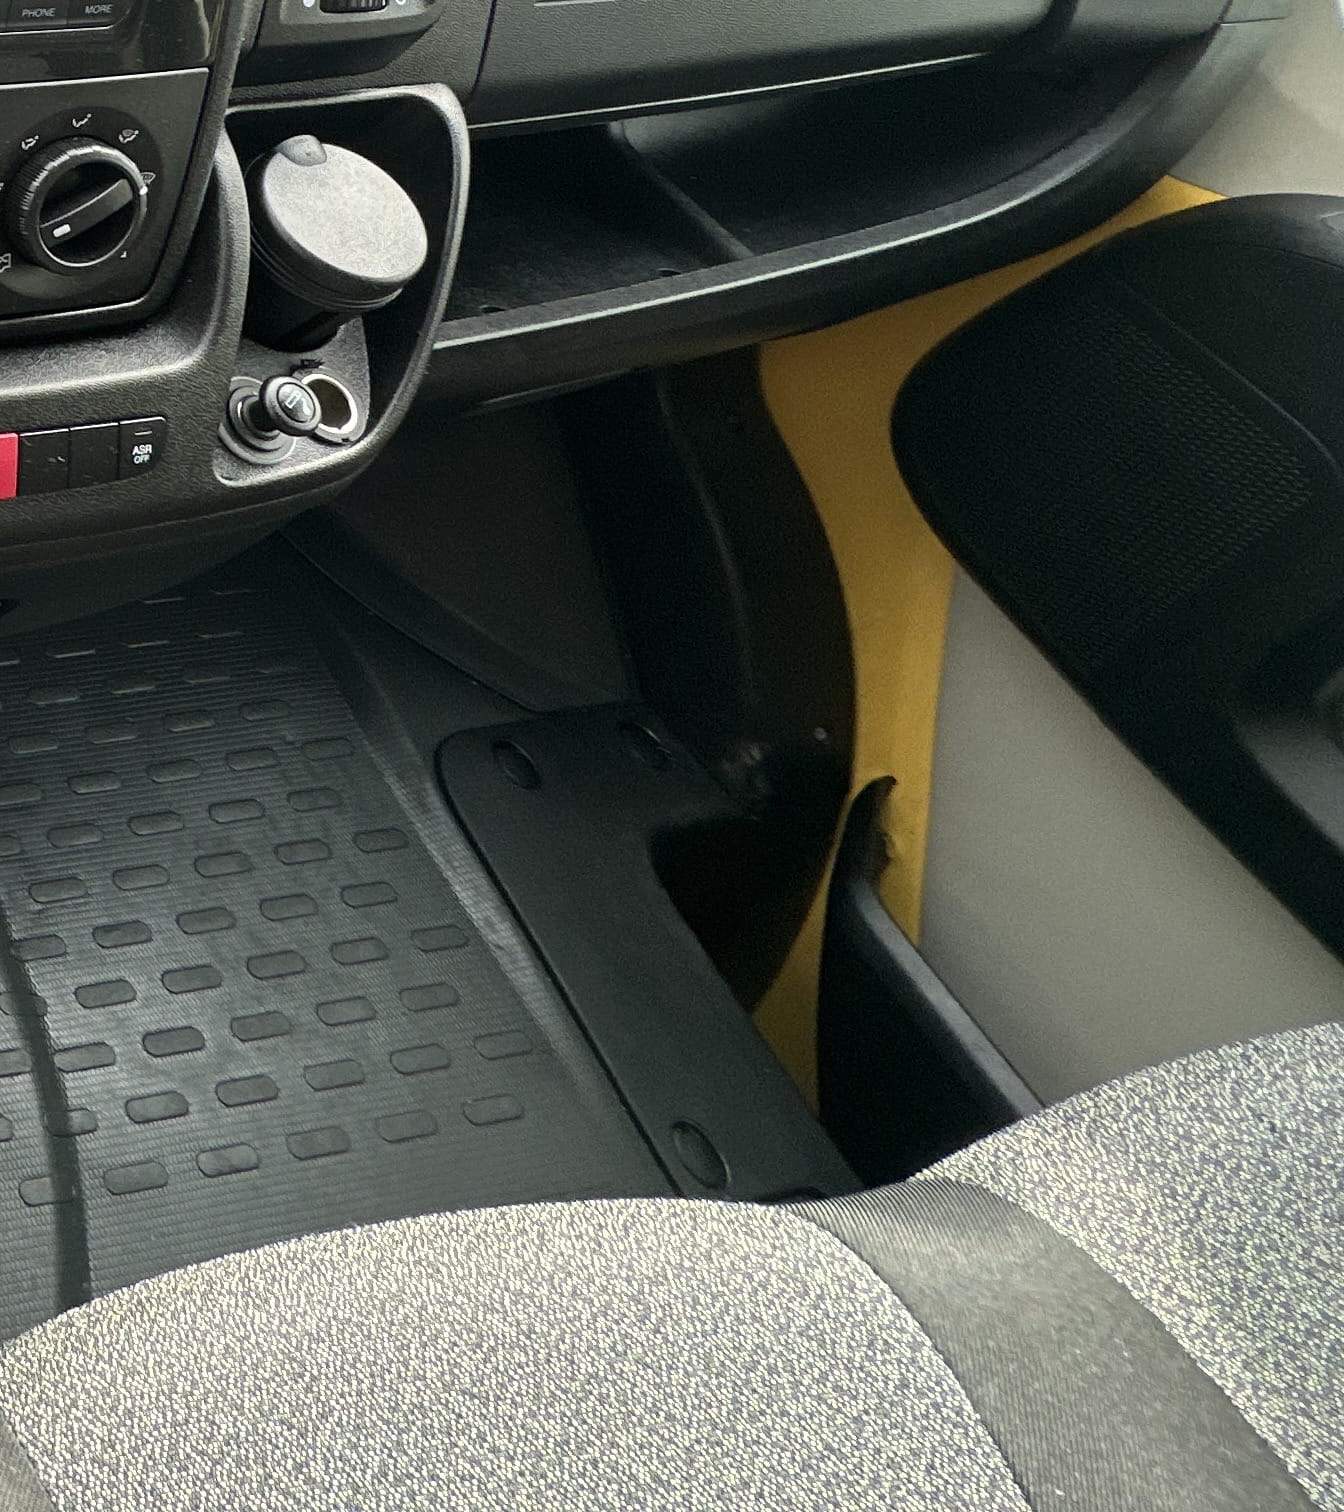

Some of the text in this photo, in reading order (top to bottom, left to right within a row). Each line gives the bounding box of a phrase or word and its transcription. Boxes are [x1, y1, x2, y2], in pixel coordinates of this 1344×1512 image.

[21, 7, 56, 18] PHONE
[84, 3, 112, 15] MORE
[132, 444, 153, 456] ASR
[133, 455, 150, 464] OFF
